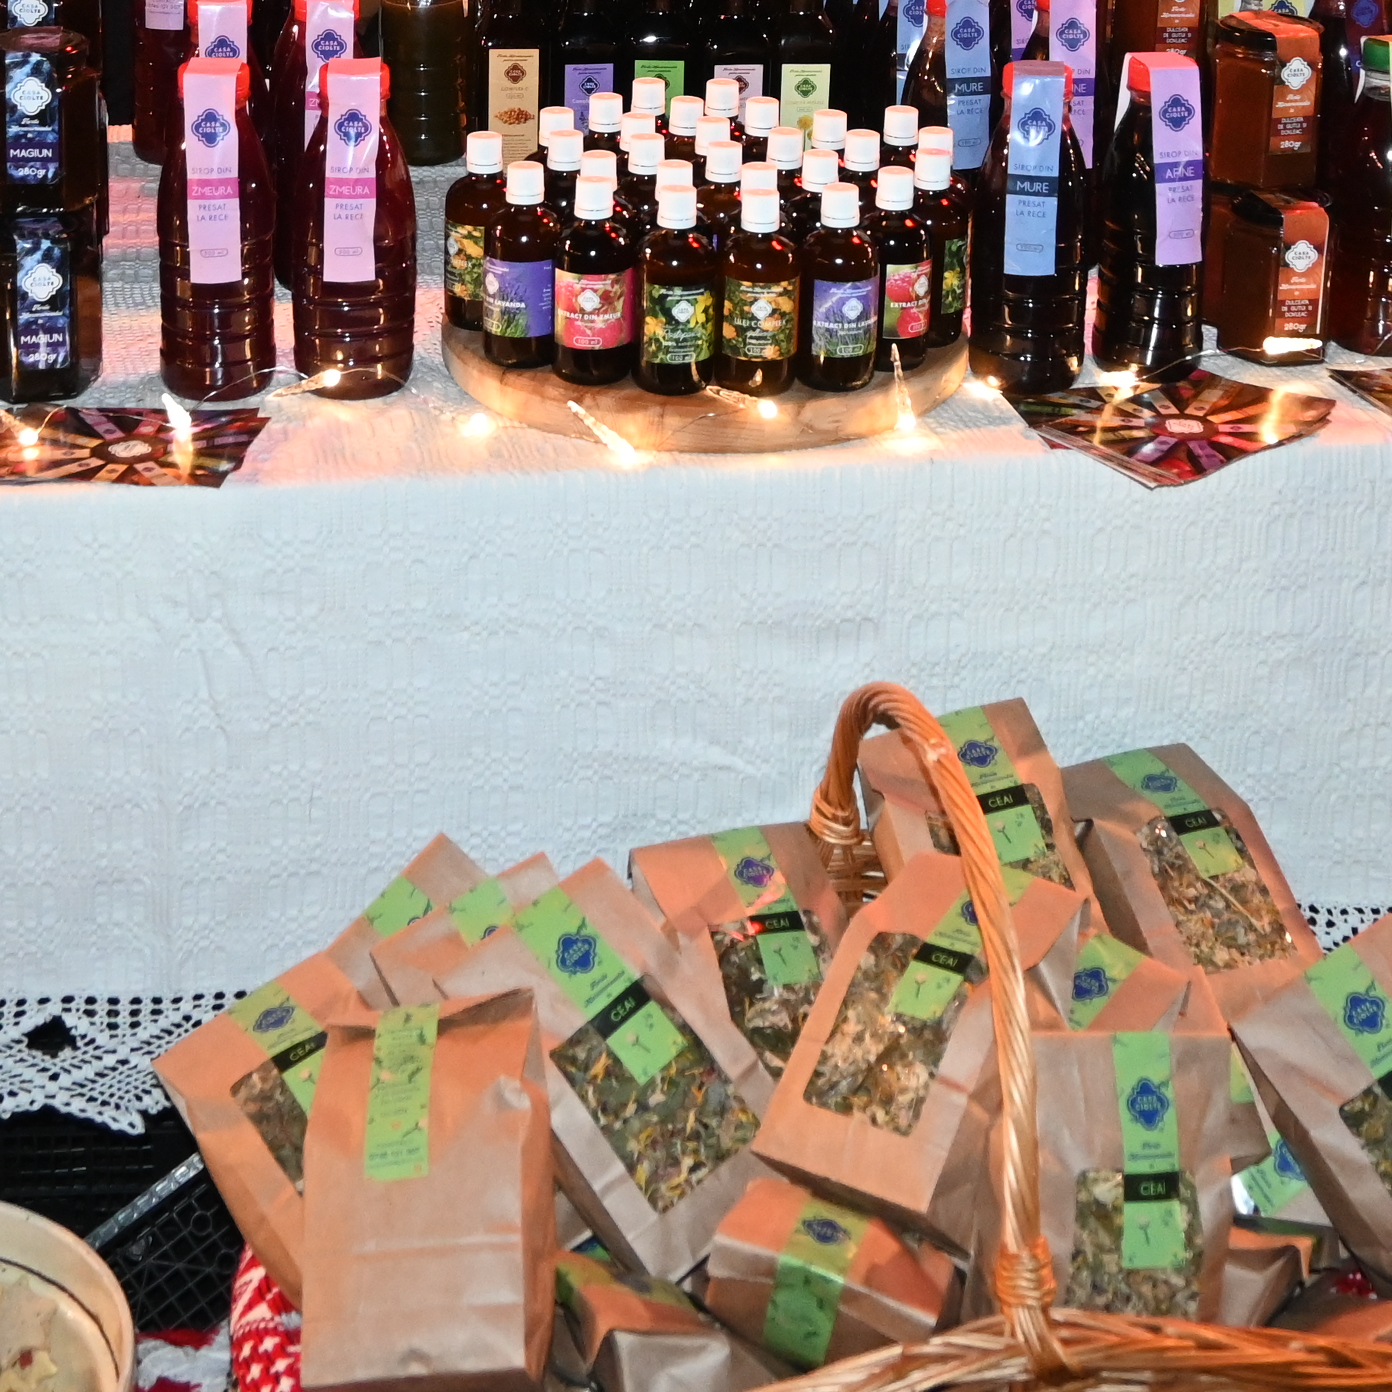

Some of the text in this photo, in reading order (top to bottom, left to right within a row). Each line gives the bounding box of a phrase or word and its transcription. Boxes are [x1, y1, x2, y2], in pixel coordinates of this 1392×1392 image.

[955, 83, 983, 93] MURE
[1280, 141, 1301, 150] 280gr
[10, 148, 52, 157] MAGIUN
[18, 167, 46, 178] 280gr
[331, 166, 353, 174] SIROP
[1013, 164, 1037, 172] SIROP
[1166, 167, 1195, 178] AFINE
[192, 186, 233, 196] ZMEURA
[330, 186, 369, 195] ZMEURA
[1016, 181, 1049, 193] MURE
[1018, 199, 1045, 208] PRESAT
[1178, 195, 1194, 203] RECE
[335, 203, 363, 211] PRESAT
[1028, 210, 1046, 218] RECE
[495, 300, 525, 308] LAVANDA
[21, 333, 63, 344] MAGIUN
[988, 793, 1013, 807] CEAI
[1185, 817, 1207, 828] CEAI
[765, 918, 790, 929] CEAI
[931, 954, 958, 967] CEAI
[611, 997, 637, 1022] CEAI
[290, 1041, 317, 1061] CEAI
[1140, 1184, 1166, 1195] CEAI
